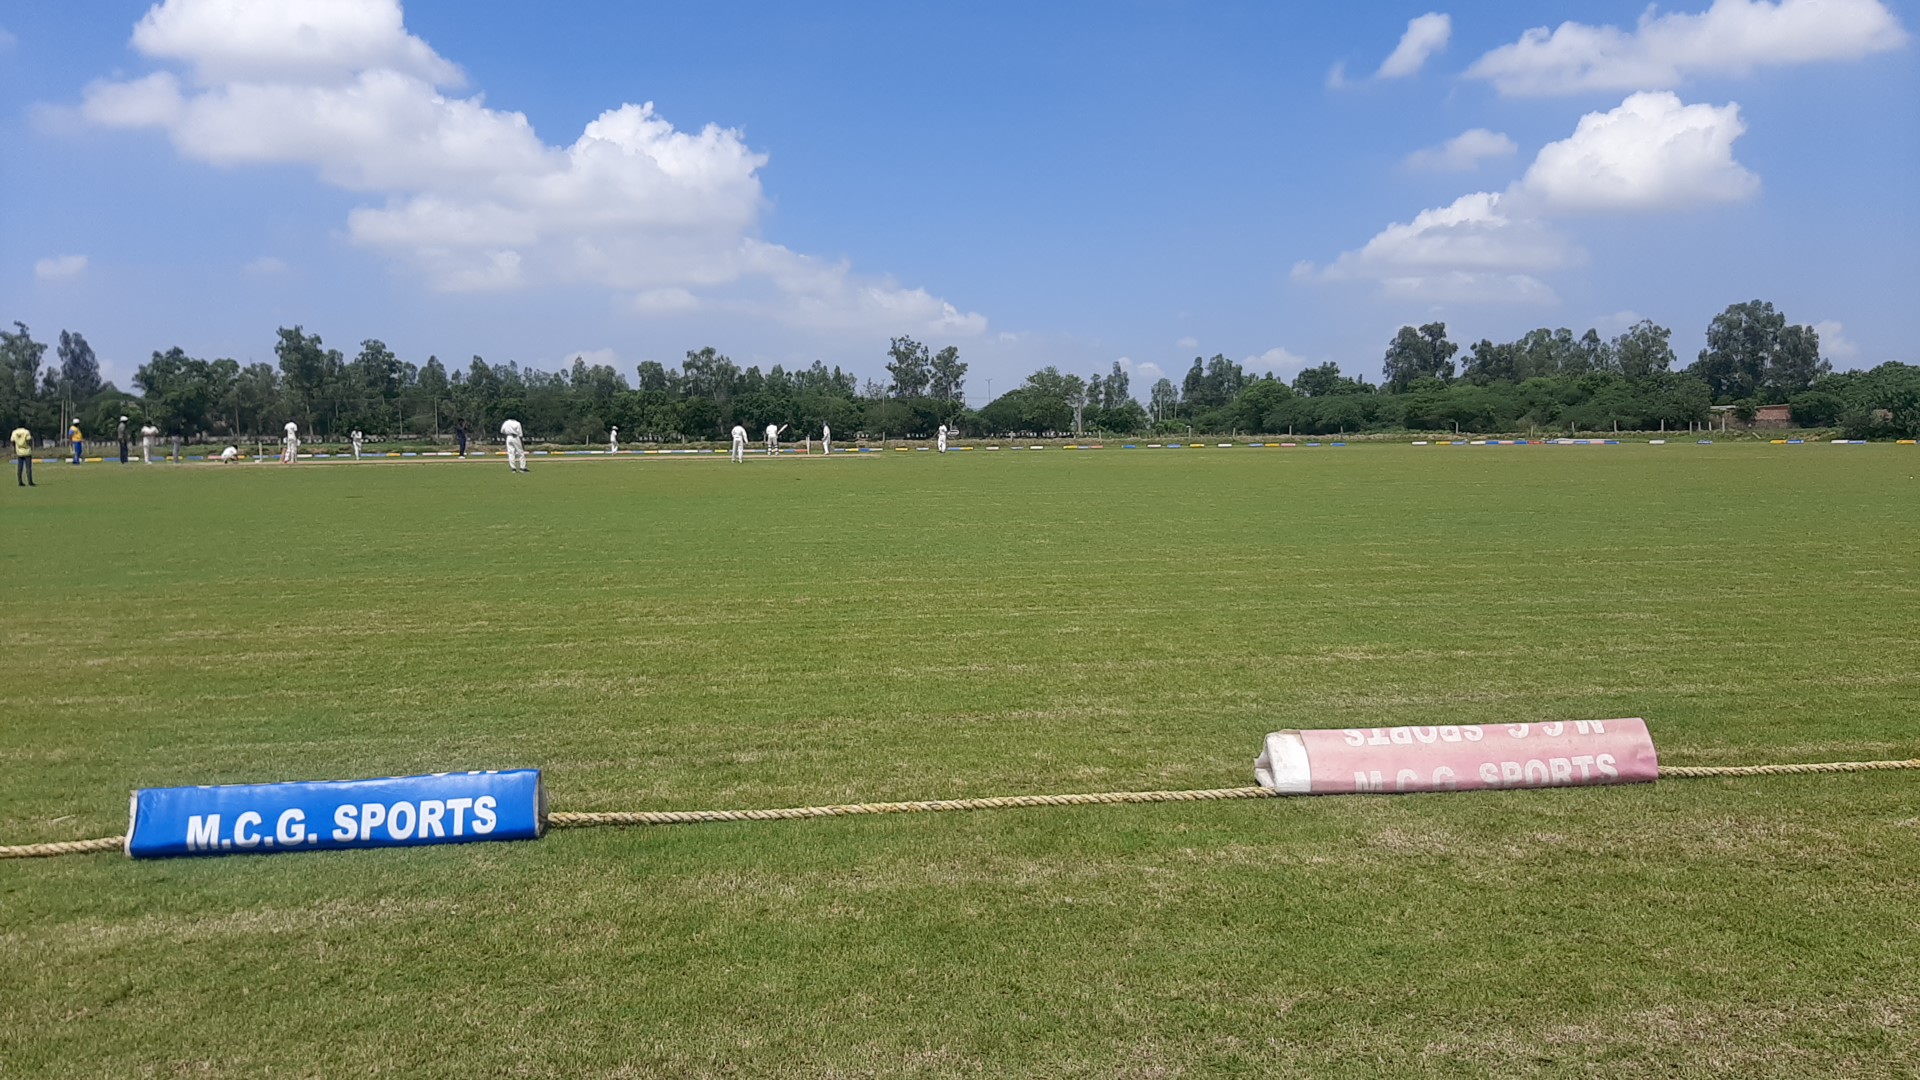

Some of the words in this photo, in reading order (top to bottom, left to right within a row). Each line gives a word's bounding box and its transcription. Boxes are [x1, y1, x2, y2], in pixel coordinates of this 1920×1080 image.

[1480, 754, 1618, 787] SPORTS
[186, 808, 318, 851] M.C.G.
[332, 795, 497, 842] SPORTS
